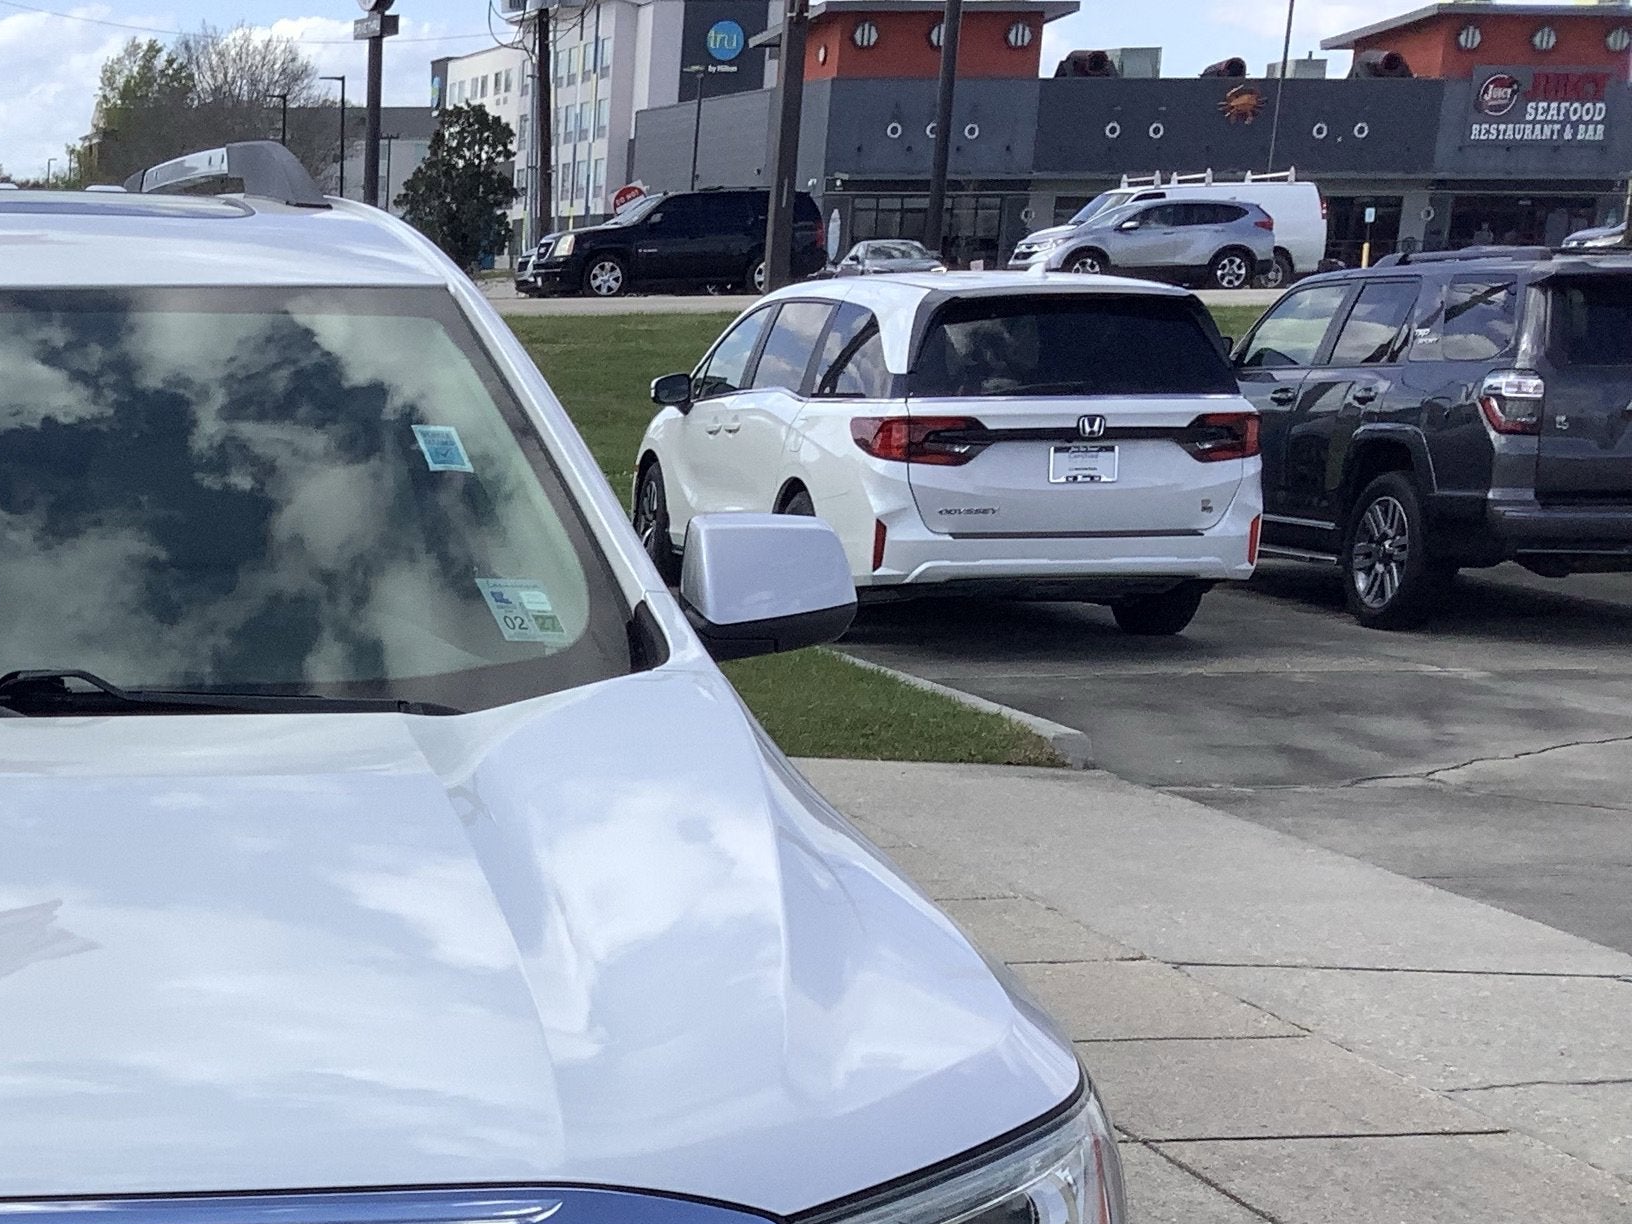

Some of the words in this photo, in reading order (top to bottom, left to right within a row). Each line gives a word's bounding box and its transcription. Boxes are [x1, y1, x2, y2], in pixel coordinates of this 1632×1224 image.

[708, 28, 737, 50] tru
[1525, 101, 1607, 121] SEAFOOD
[1470, 123, 1562, 141] RESTAURANT
[1563, 123, 1574, 141] &
[1576, 123, 1606, 141] BAR
[938, 506, 1000, 516] ODYSSEY
[503, 615, 529, 631] 02
